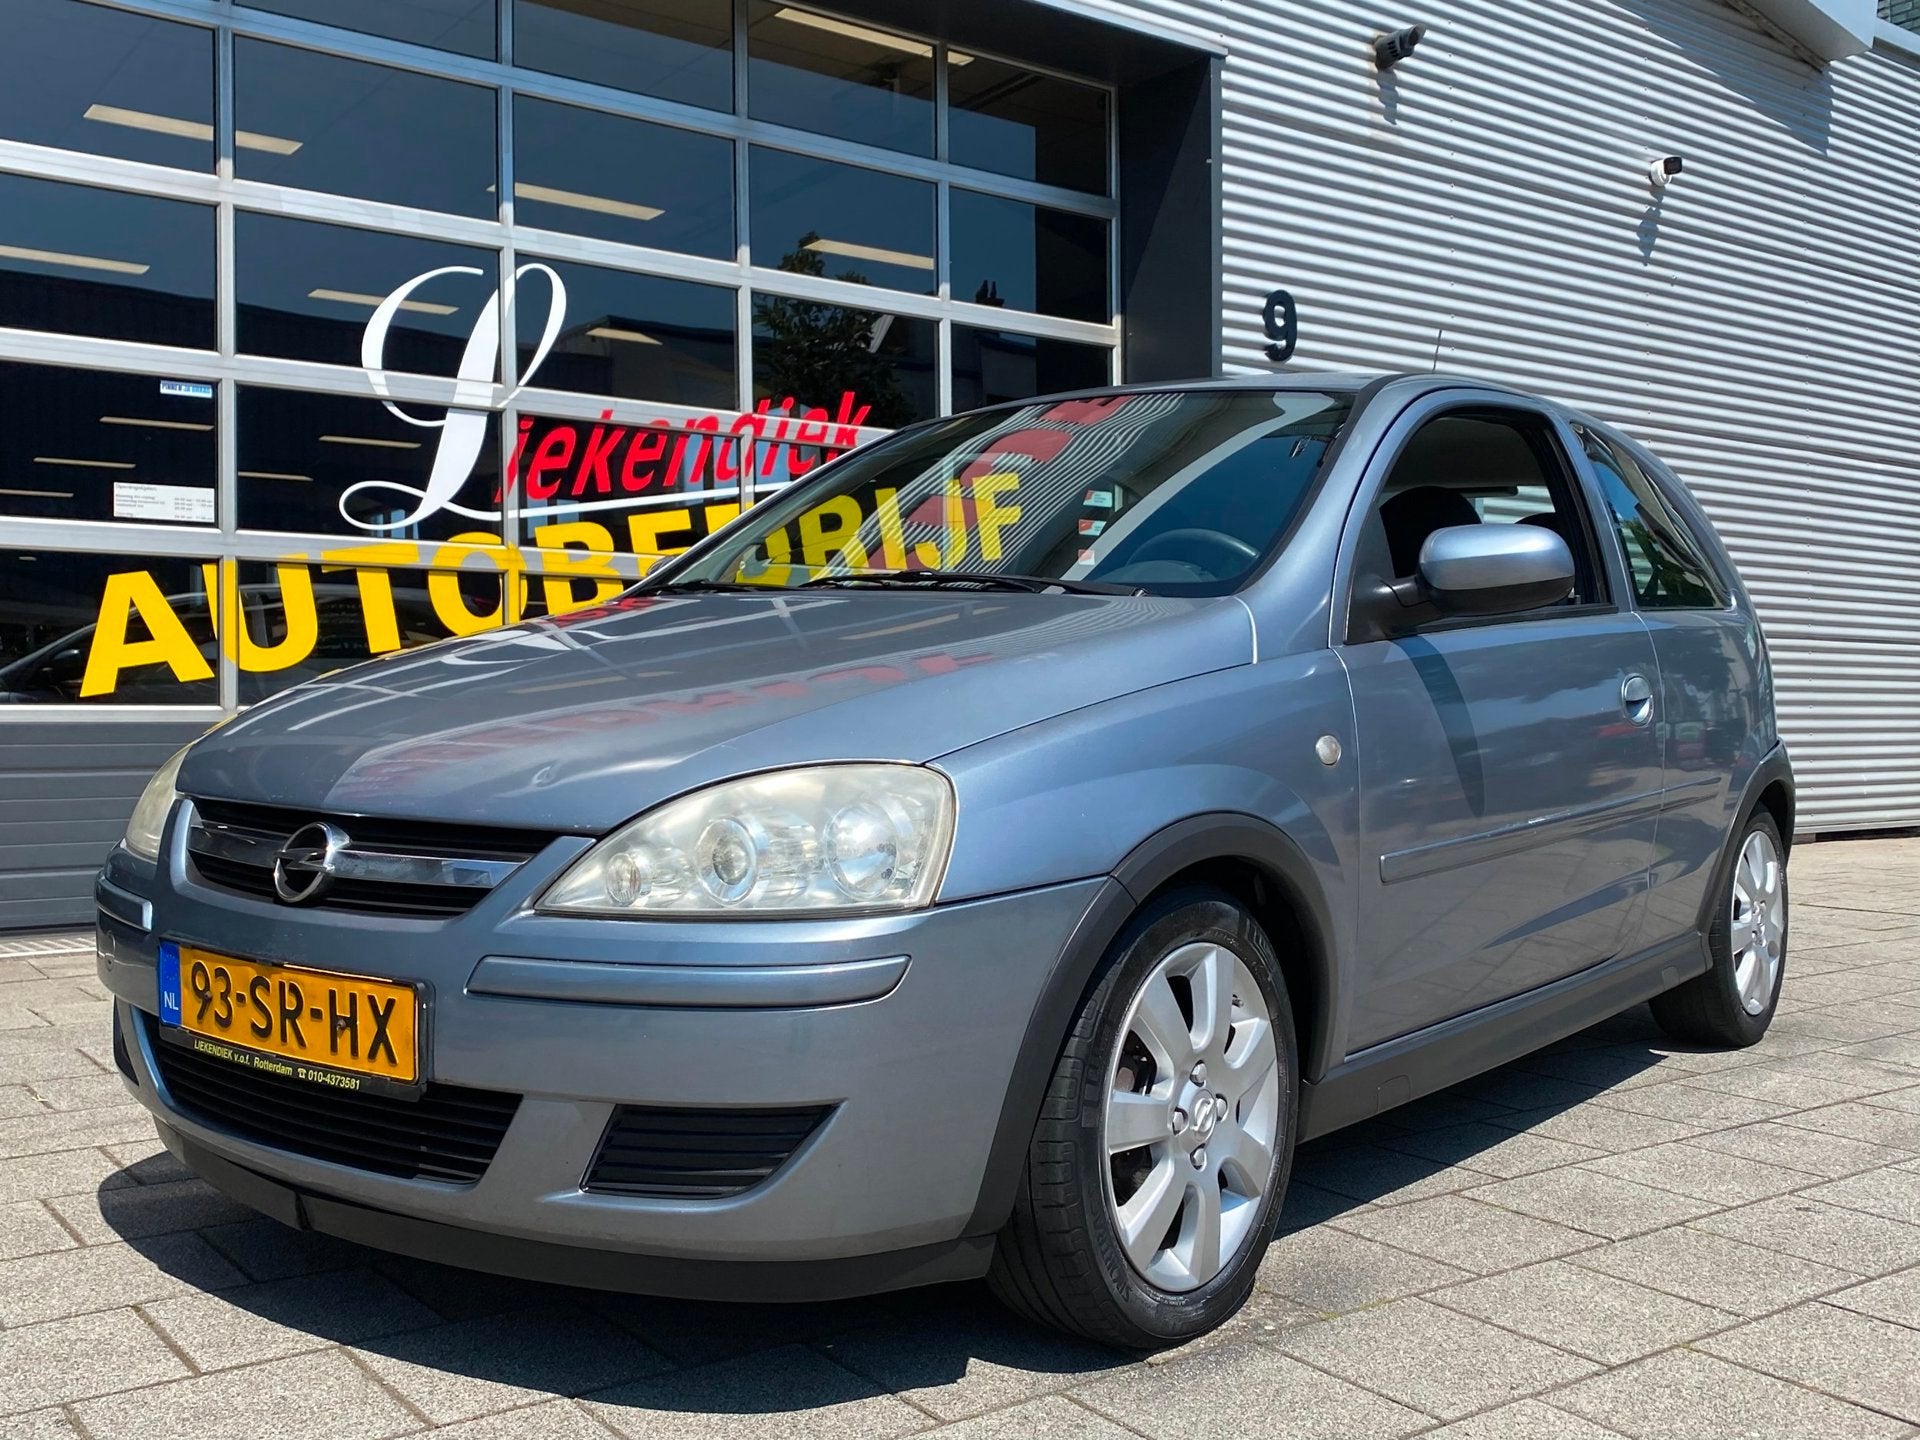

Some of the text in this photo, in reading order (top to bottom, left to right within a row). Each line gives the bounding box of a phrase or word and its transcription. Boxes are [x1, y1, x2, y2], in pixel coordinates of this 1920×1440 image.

[1264, 290, 1297, 361] 9
[163, 959, 399, 1065] NL 93-SR-HX
[194, 1038, 233, 1061] LIEKENDIEK
[253, 1057, 293, 1077] Rotterdam
[307, 1068, 361, 1091] 010-4373581
